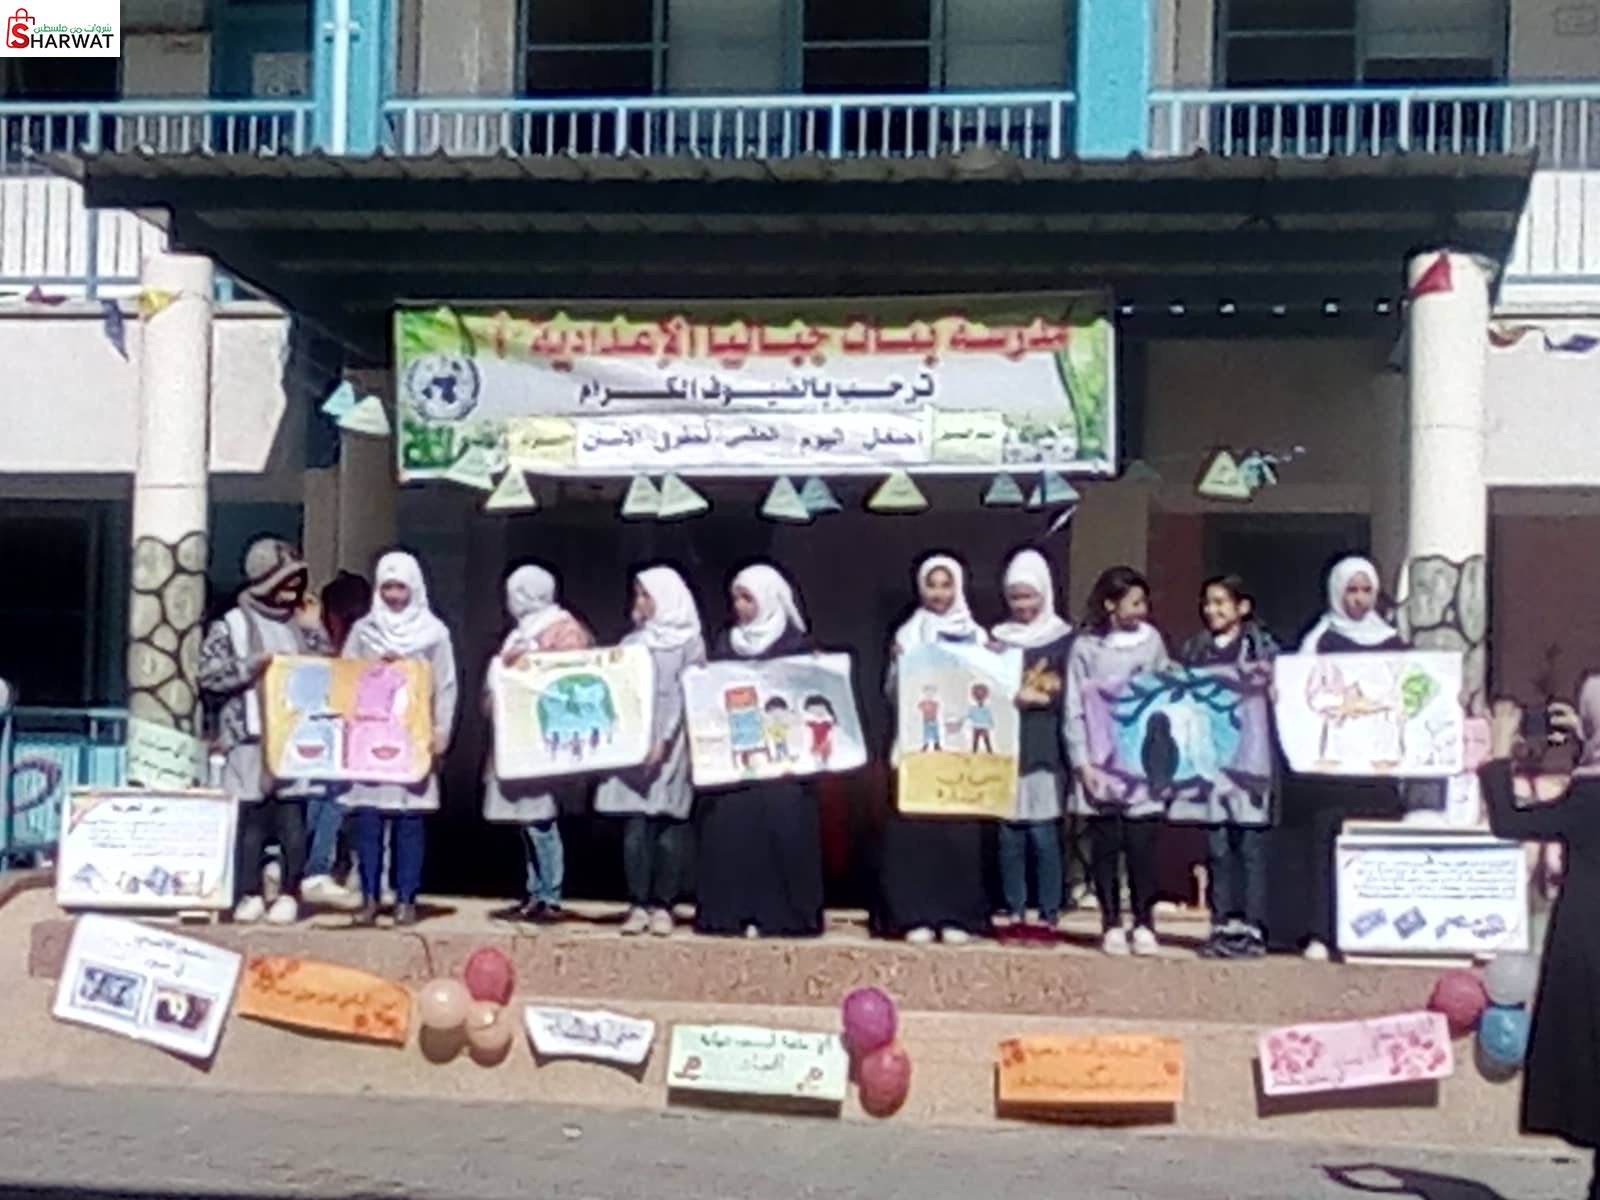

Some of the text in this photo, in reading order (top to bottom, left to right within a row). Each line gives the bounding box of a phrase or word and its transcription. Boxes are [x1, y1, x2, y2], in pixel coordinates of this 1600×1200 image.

[532, 316, 697, 371] الإعدادية
[706, 316, 830, 368] جباليا
[842, 318, 938, 367] بنات
[950, 315, 1070, 362] مدرسة
[579, 376, 699, 407] الكرام
[835, 373, 935, 405] ترحب
